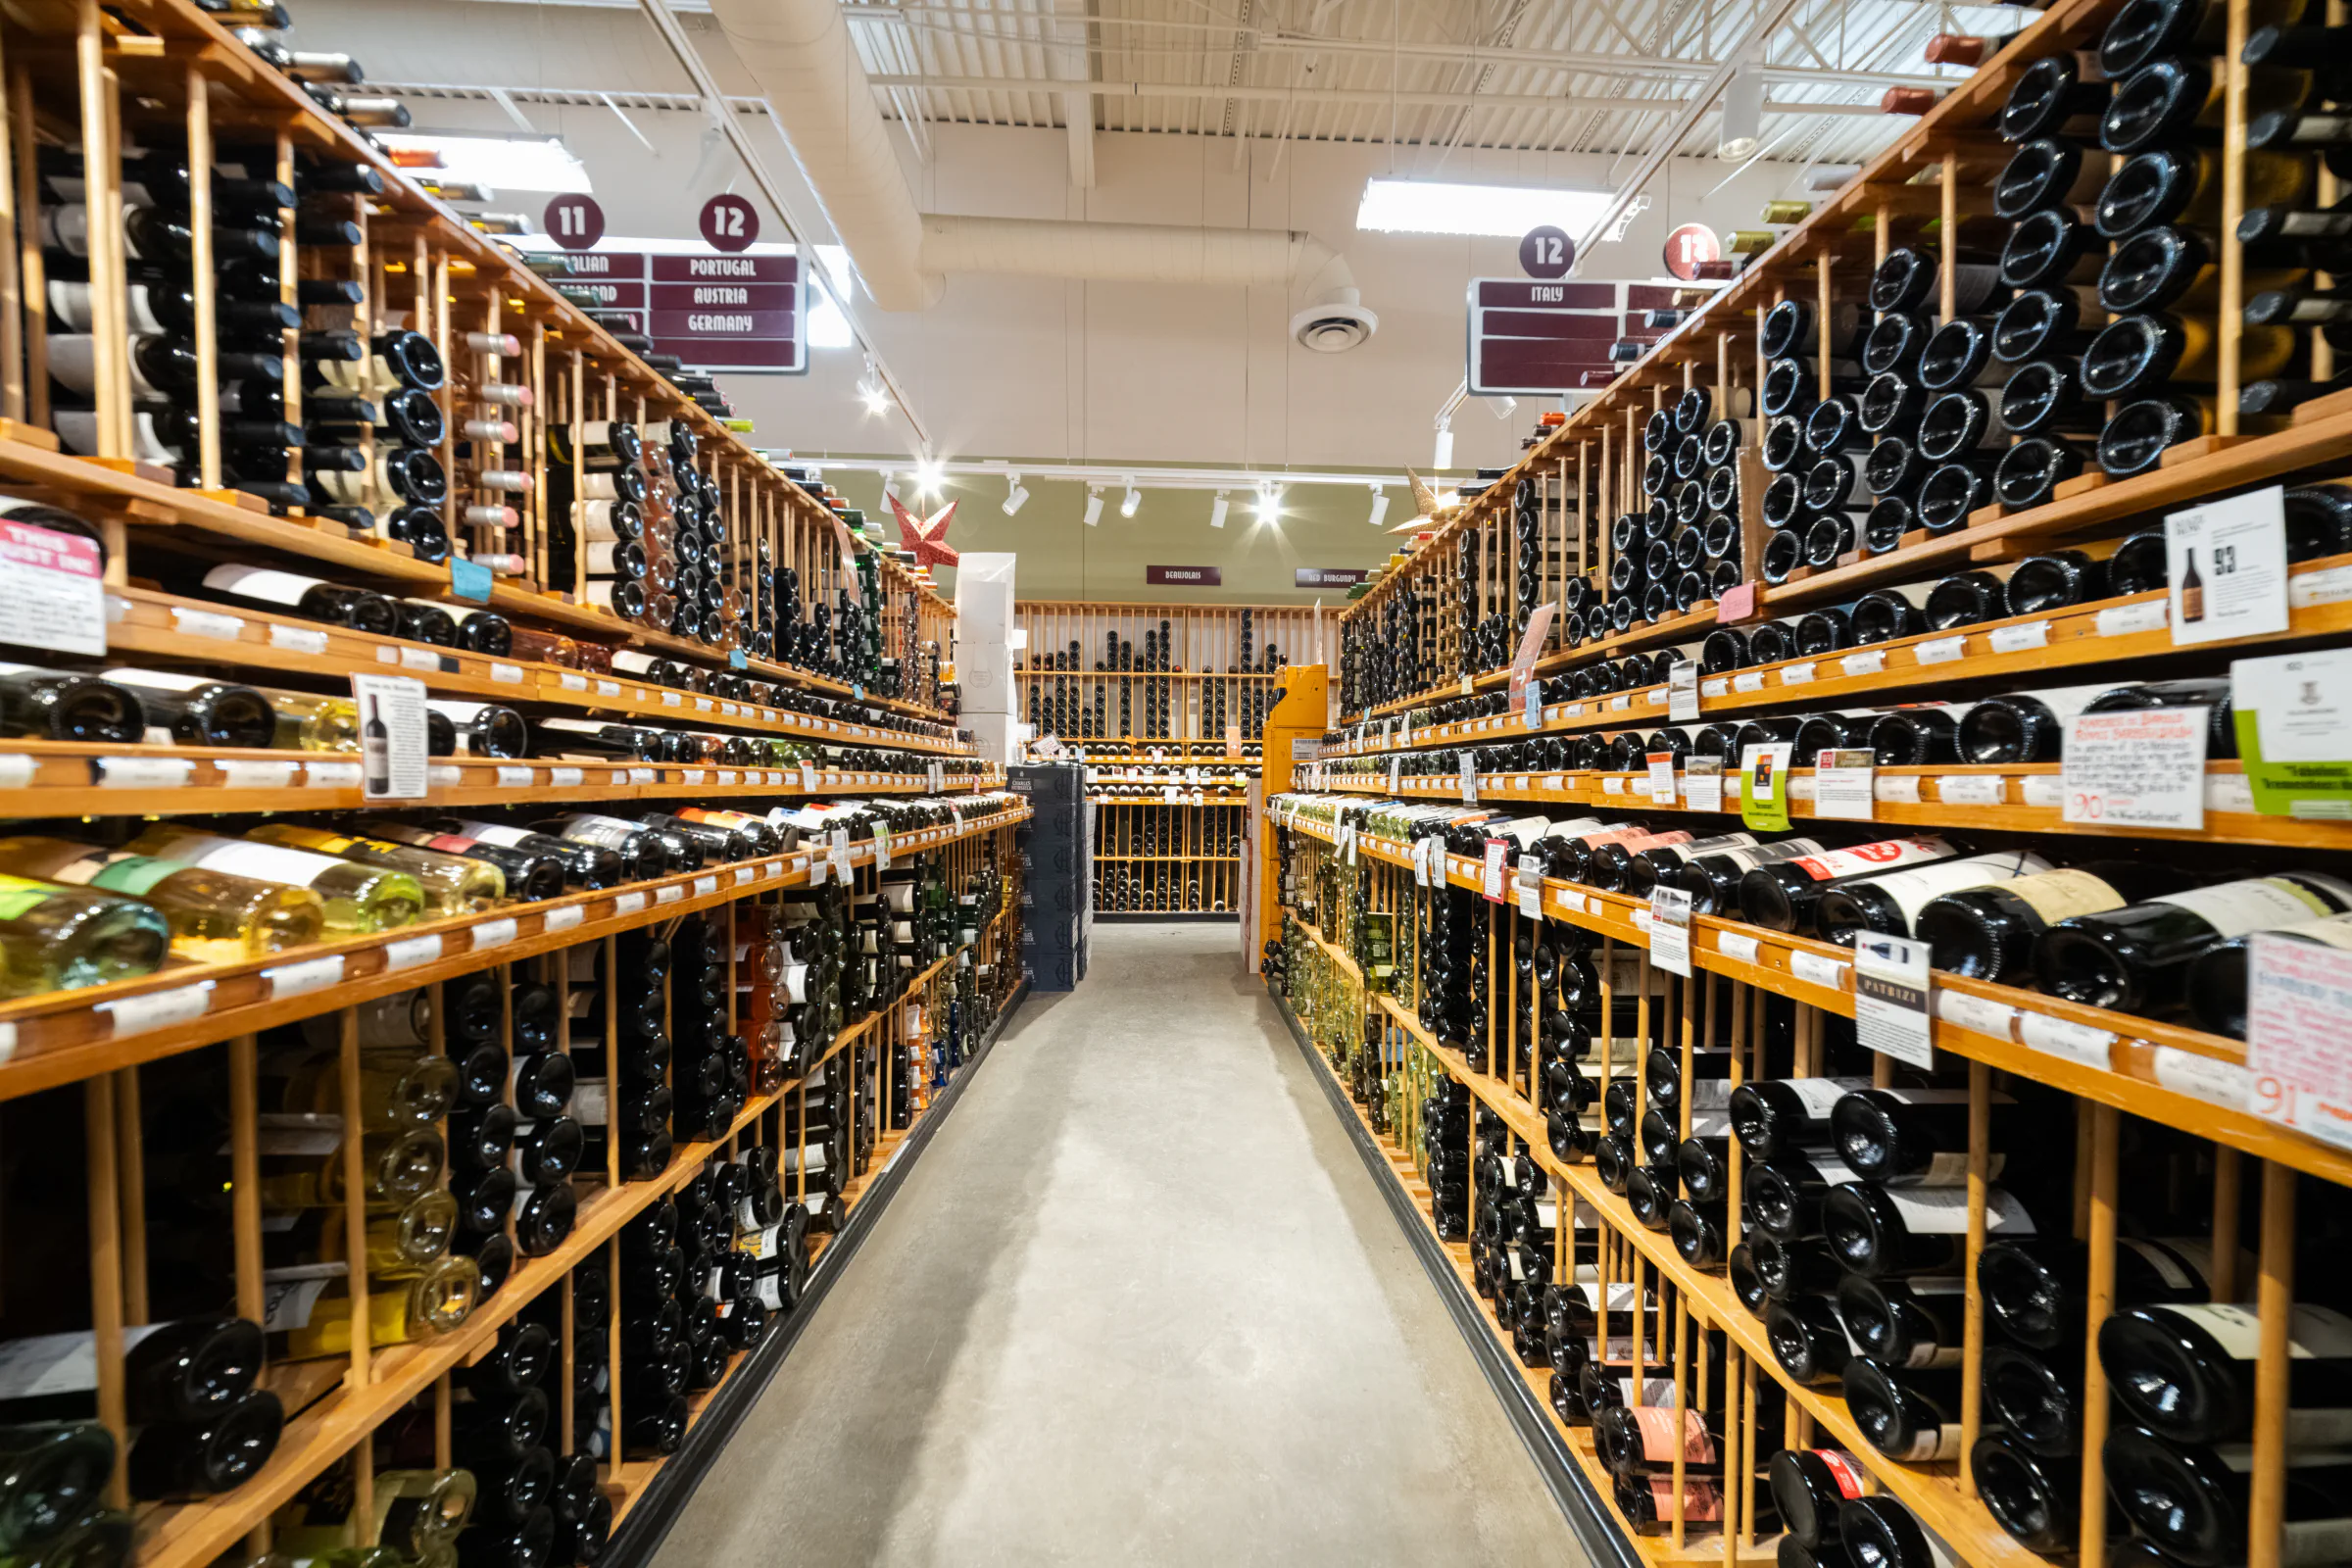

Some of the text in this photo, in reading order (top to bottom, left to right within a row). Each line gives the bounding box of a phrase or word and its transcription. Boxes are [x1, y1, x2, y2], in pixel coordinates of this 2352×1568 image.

[560, 206, 585, 236] 11
[714, 206, 745, 237] 12
[1535, 236, 1563, 265] 12
[690, 259, 757, 277] PORTUGAL
[694, 286, 748, 305] AUSTRIA
[1531, 286, 1564, 303] ITALY
[688, 314, 753, 332] GERMANY
[1164, 570, 1201, 580] BEAUJOLAIS
[1323, 574, 1356, 584] BURGUNDY
[2255, 1076, 2297, 1126] 91
